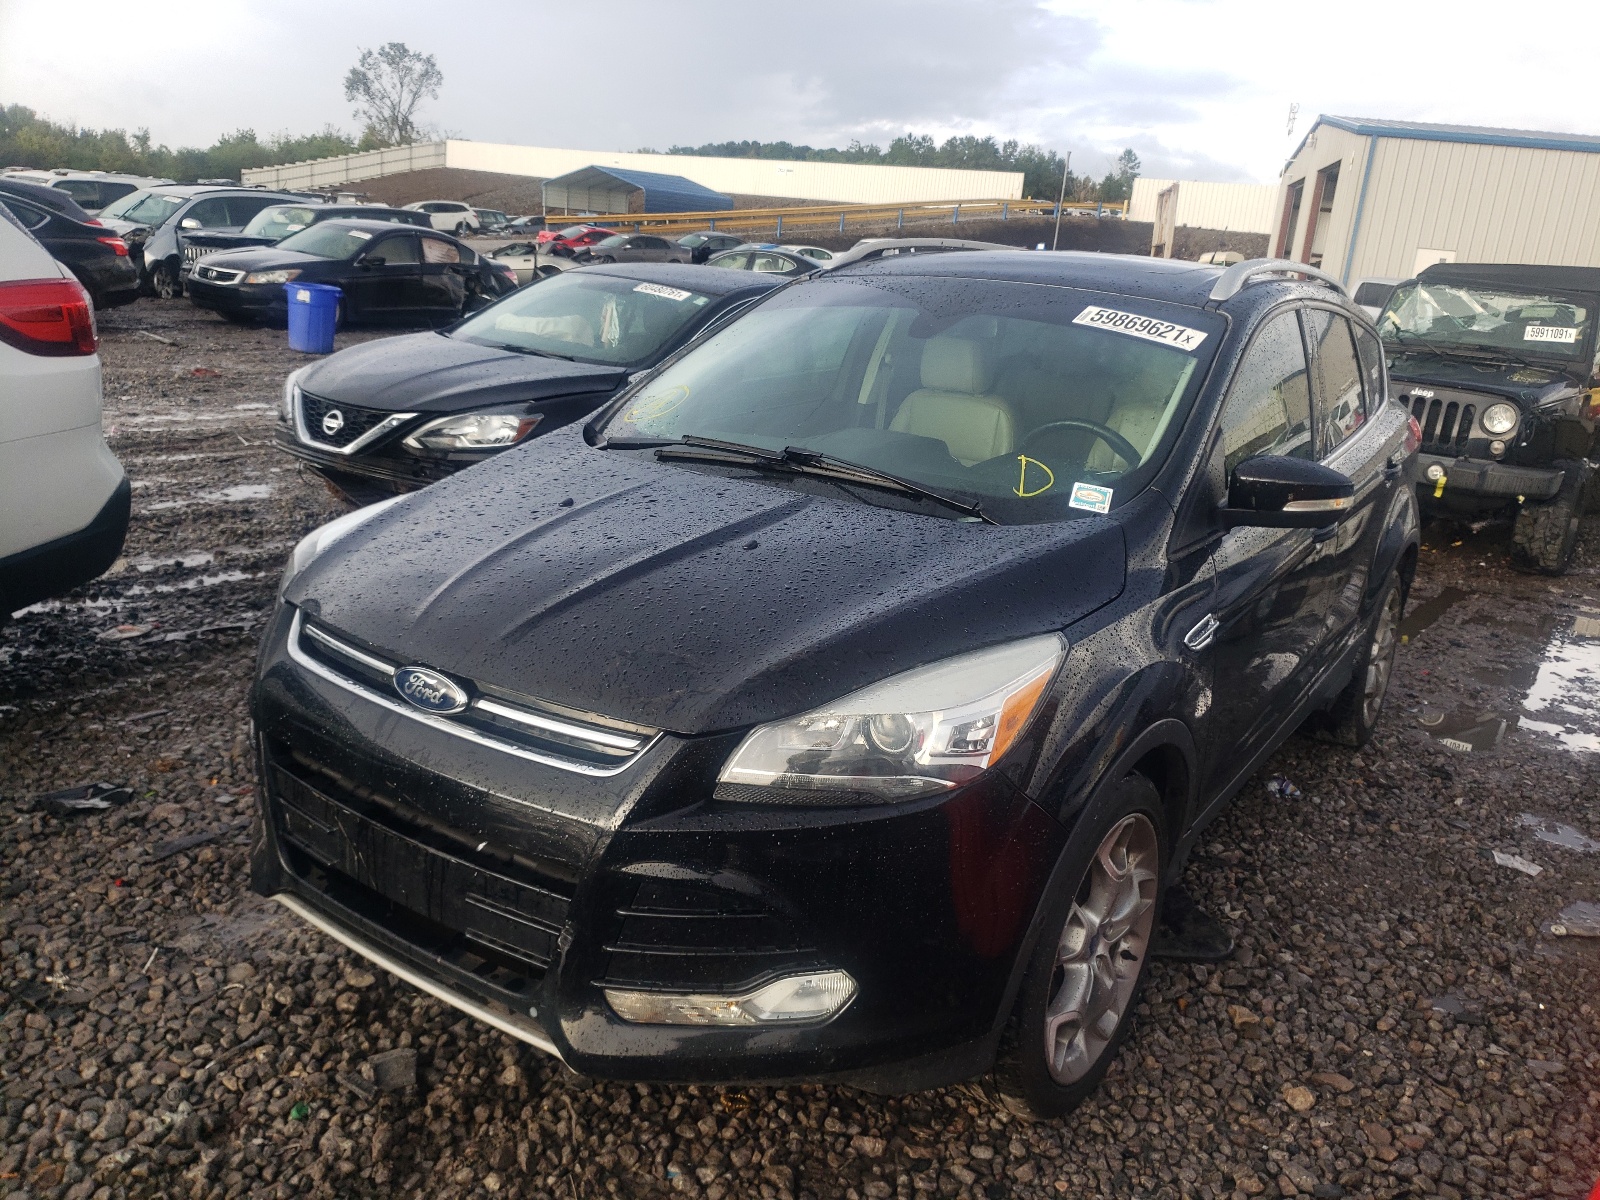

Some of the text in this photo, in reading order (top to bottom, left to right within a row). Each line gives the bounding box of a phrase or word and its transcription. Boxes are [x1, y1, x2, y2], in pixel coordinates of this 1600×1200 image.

[1410, 387, 1435, 399] Jeep
[1013, 454, 1055, 497] D
[404, 672, 447, 705] Ford
